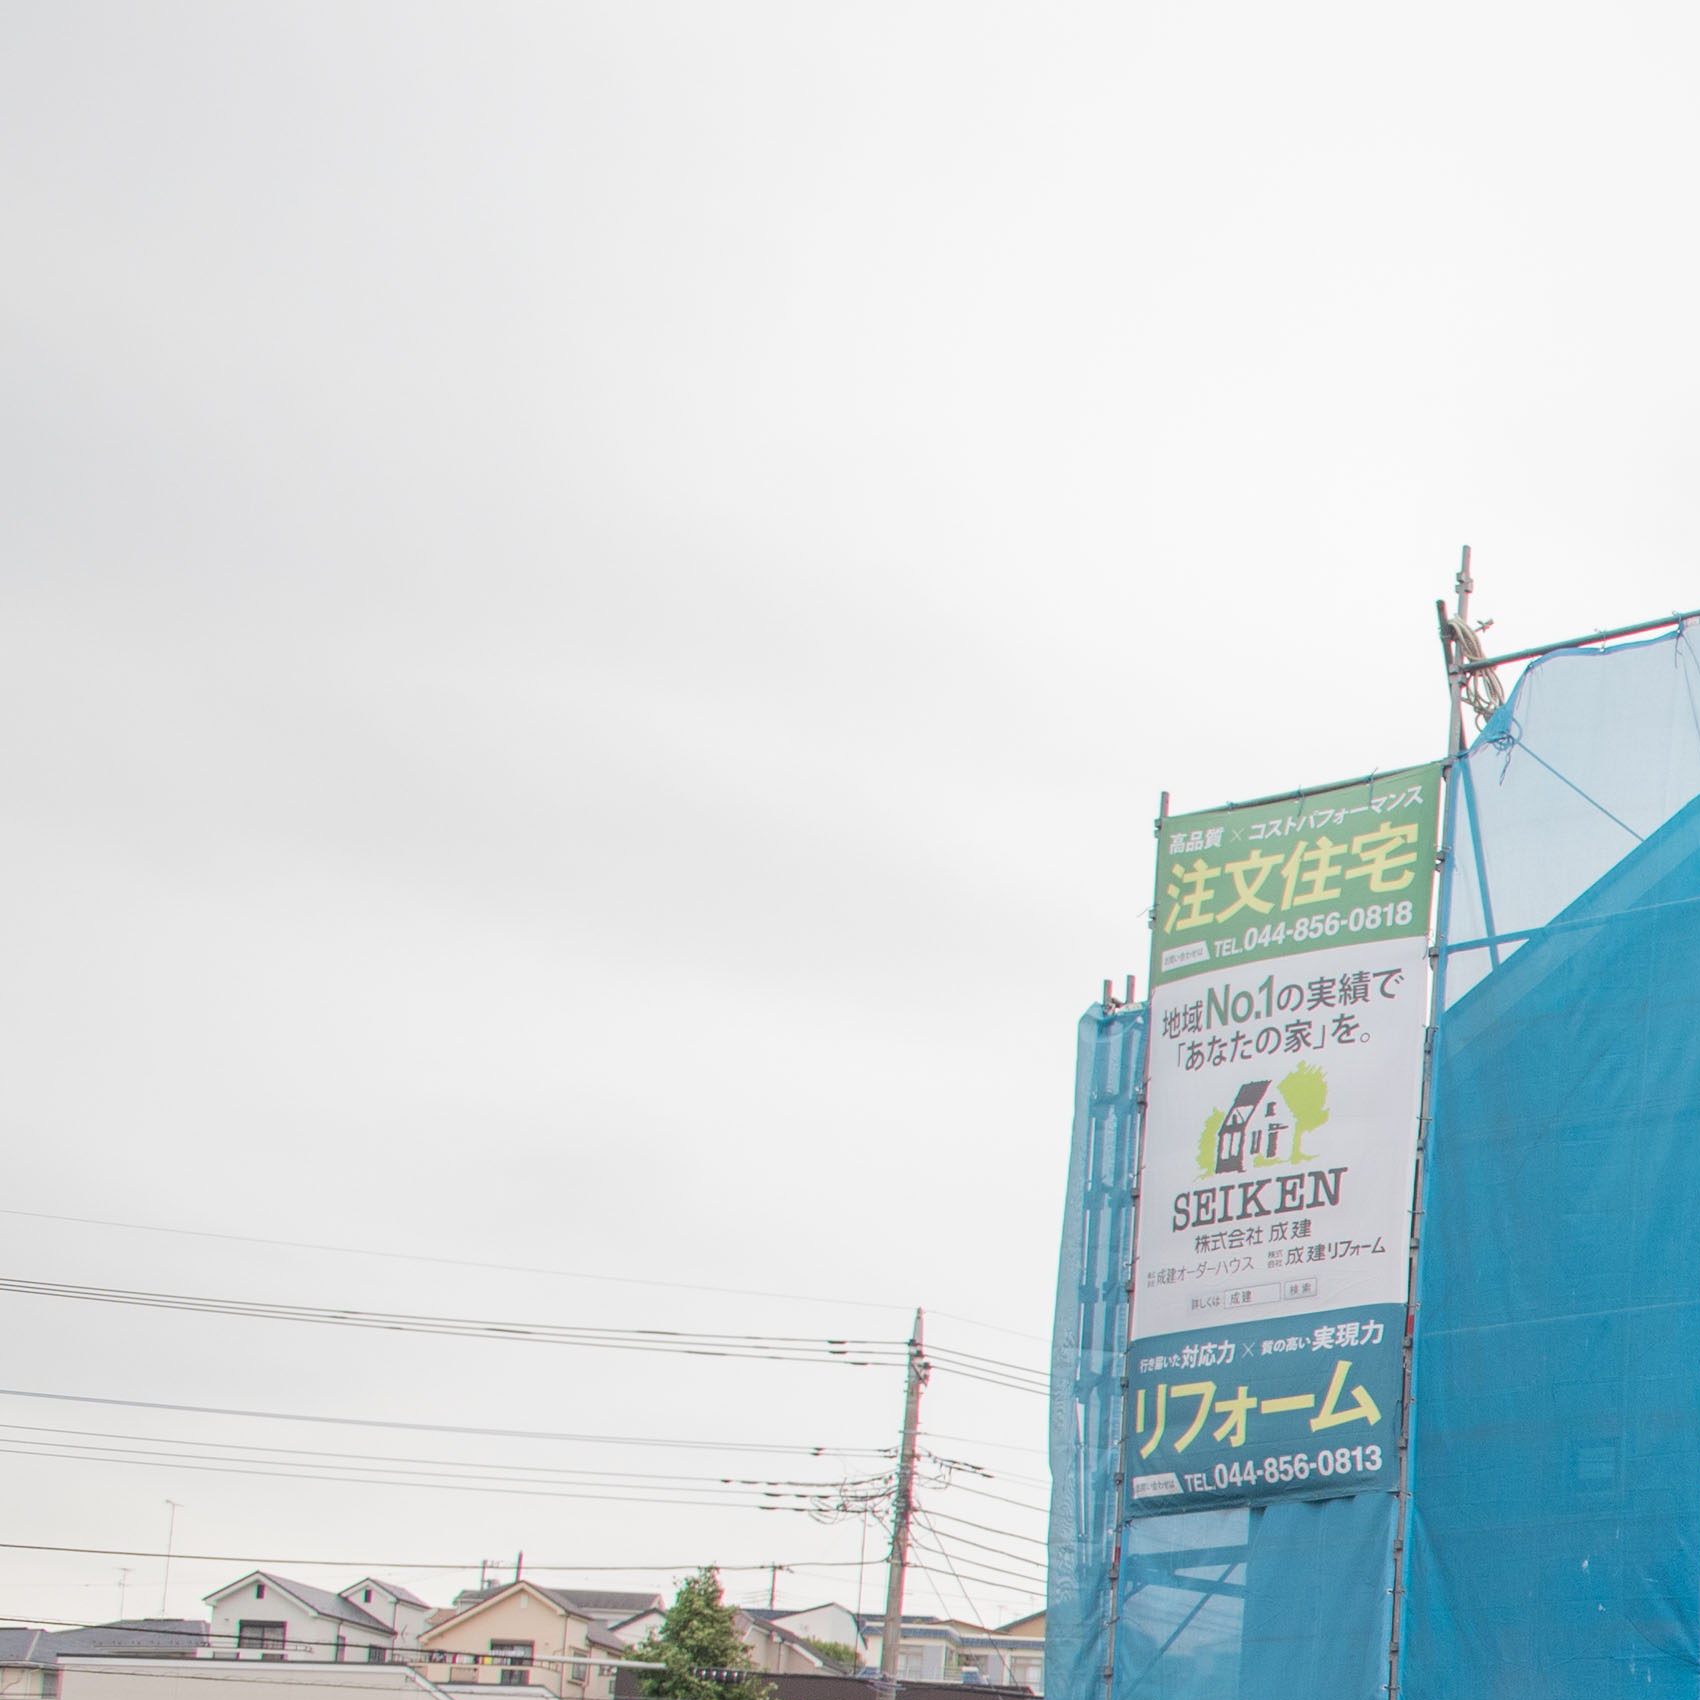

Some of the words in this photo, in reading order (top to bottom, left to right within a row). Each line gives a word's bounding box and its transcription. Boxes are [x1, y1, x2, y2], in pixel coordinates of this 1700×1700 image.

[1169, 827, 1225, 855] 高品質
[1249, 785, 1424, 841] コストパフォーマンス
[1164, 821, 1419, 934] 注文住宅
[1162, 967, 1405, 1040] 地域No.1の実績で
[1177, 1012, 1371, 1072] 「あなたの家」を。
[1172, 1167, 1349, 1233] SEIKEN
[1195, 1226, 1263, 1255] 株式会社
[1268, 1218, 1313, 1243] 成建
[1285, 1236, 1387, 1267] 成建リフォーム
[1139, 1339, 1236, 1374] 行き届いた対応力
[1260, 1319, 1384, 1356] 質の高い実現力
[1136, 1359, 1382, 1460] リフォーム
